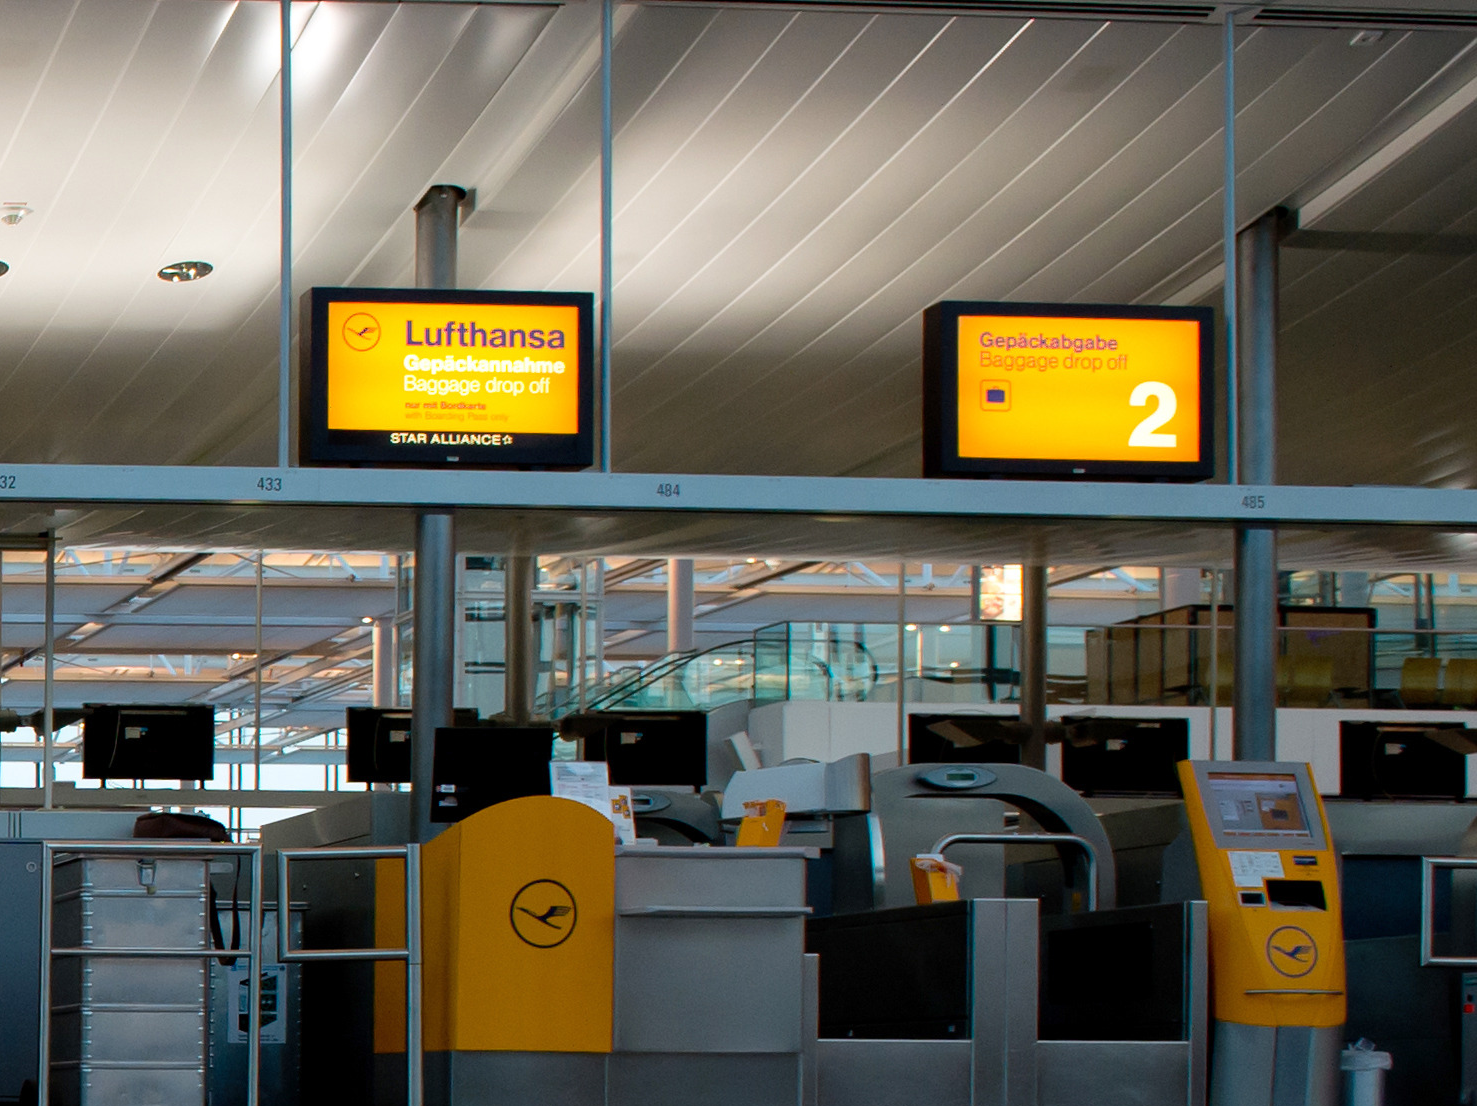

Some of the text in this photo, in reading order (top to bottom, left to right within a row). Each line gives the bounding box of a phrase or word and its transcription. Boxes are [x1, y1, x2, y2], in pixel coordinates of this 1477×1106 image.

[406, 320, 564, 349] Lufthansa
[980, 332, 1118, 352] Gepäckabgabe
[404, 354, 565, 374] Gepäckannahme
[980, 352, 1128, 372] Baggage drop off
[404, 375, 550, 396] Baggage drop off
[1128, 381, 1178, 448] 2
[390, 433, 502, 445] STAR ALLIANCE
[257, 477, 282, 492] 433
[657, 484, 680, 498] 484
